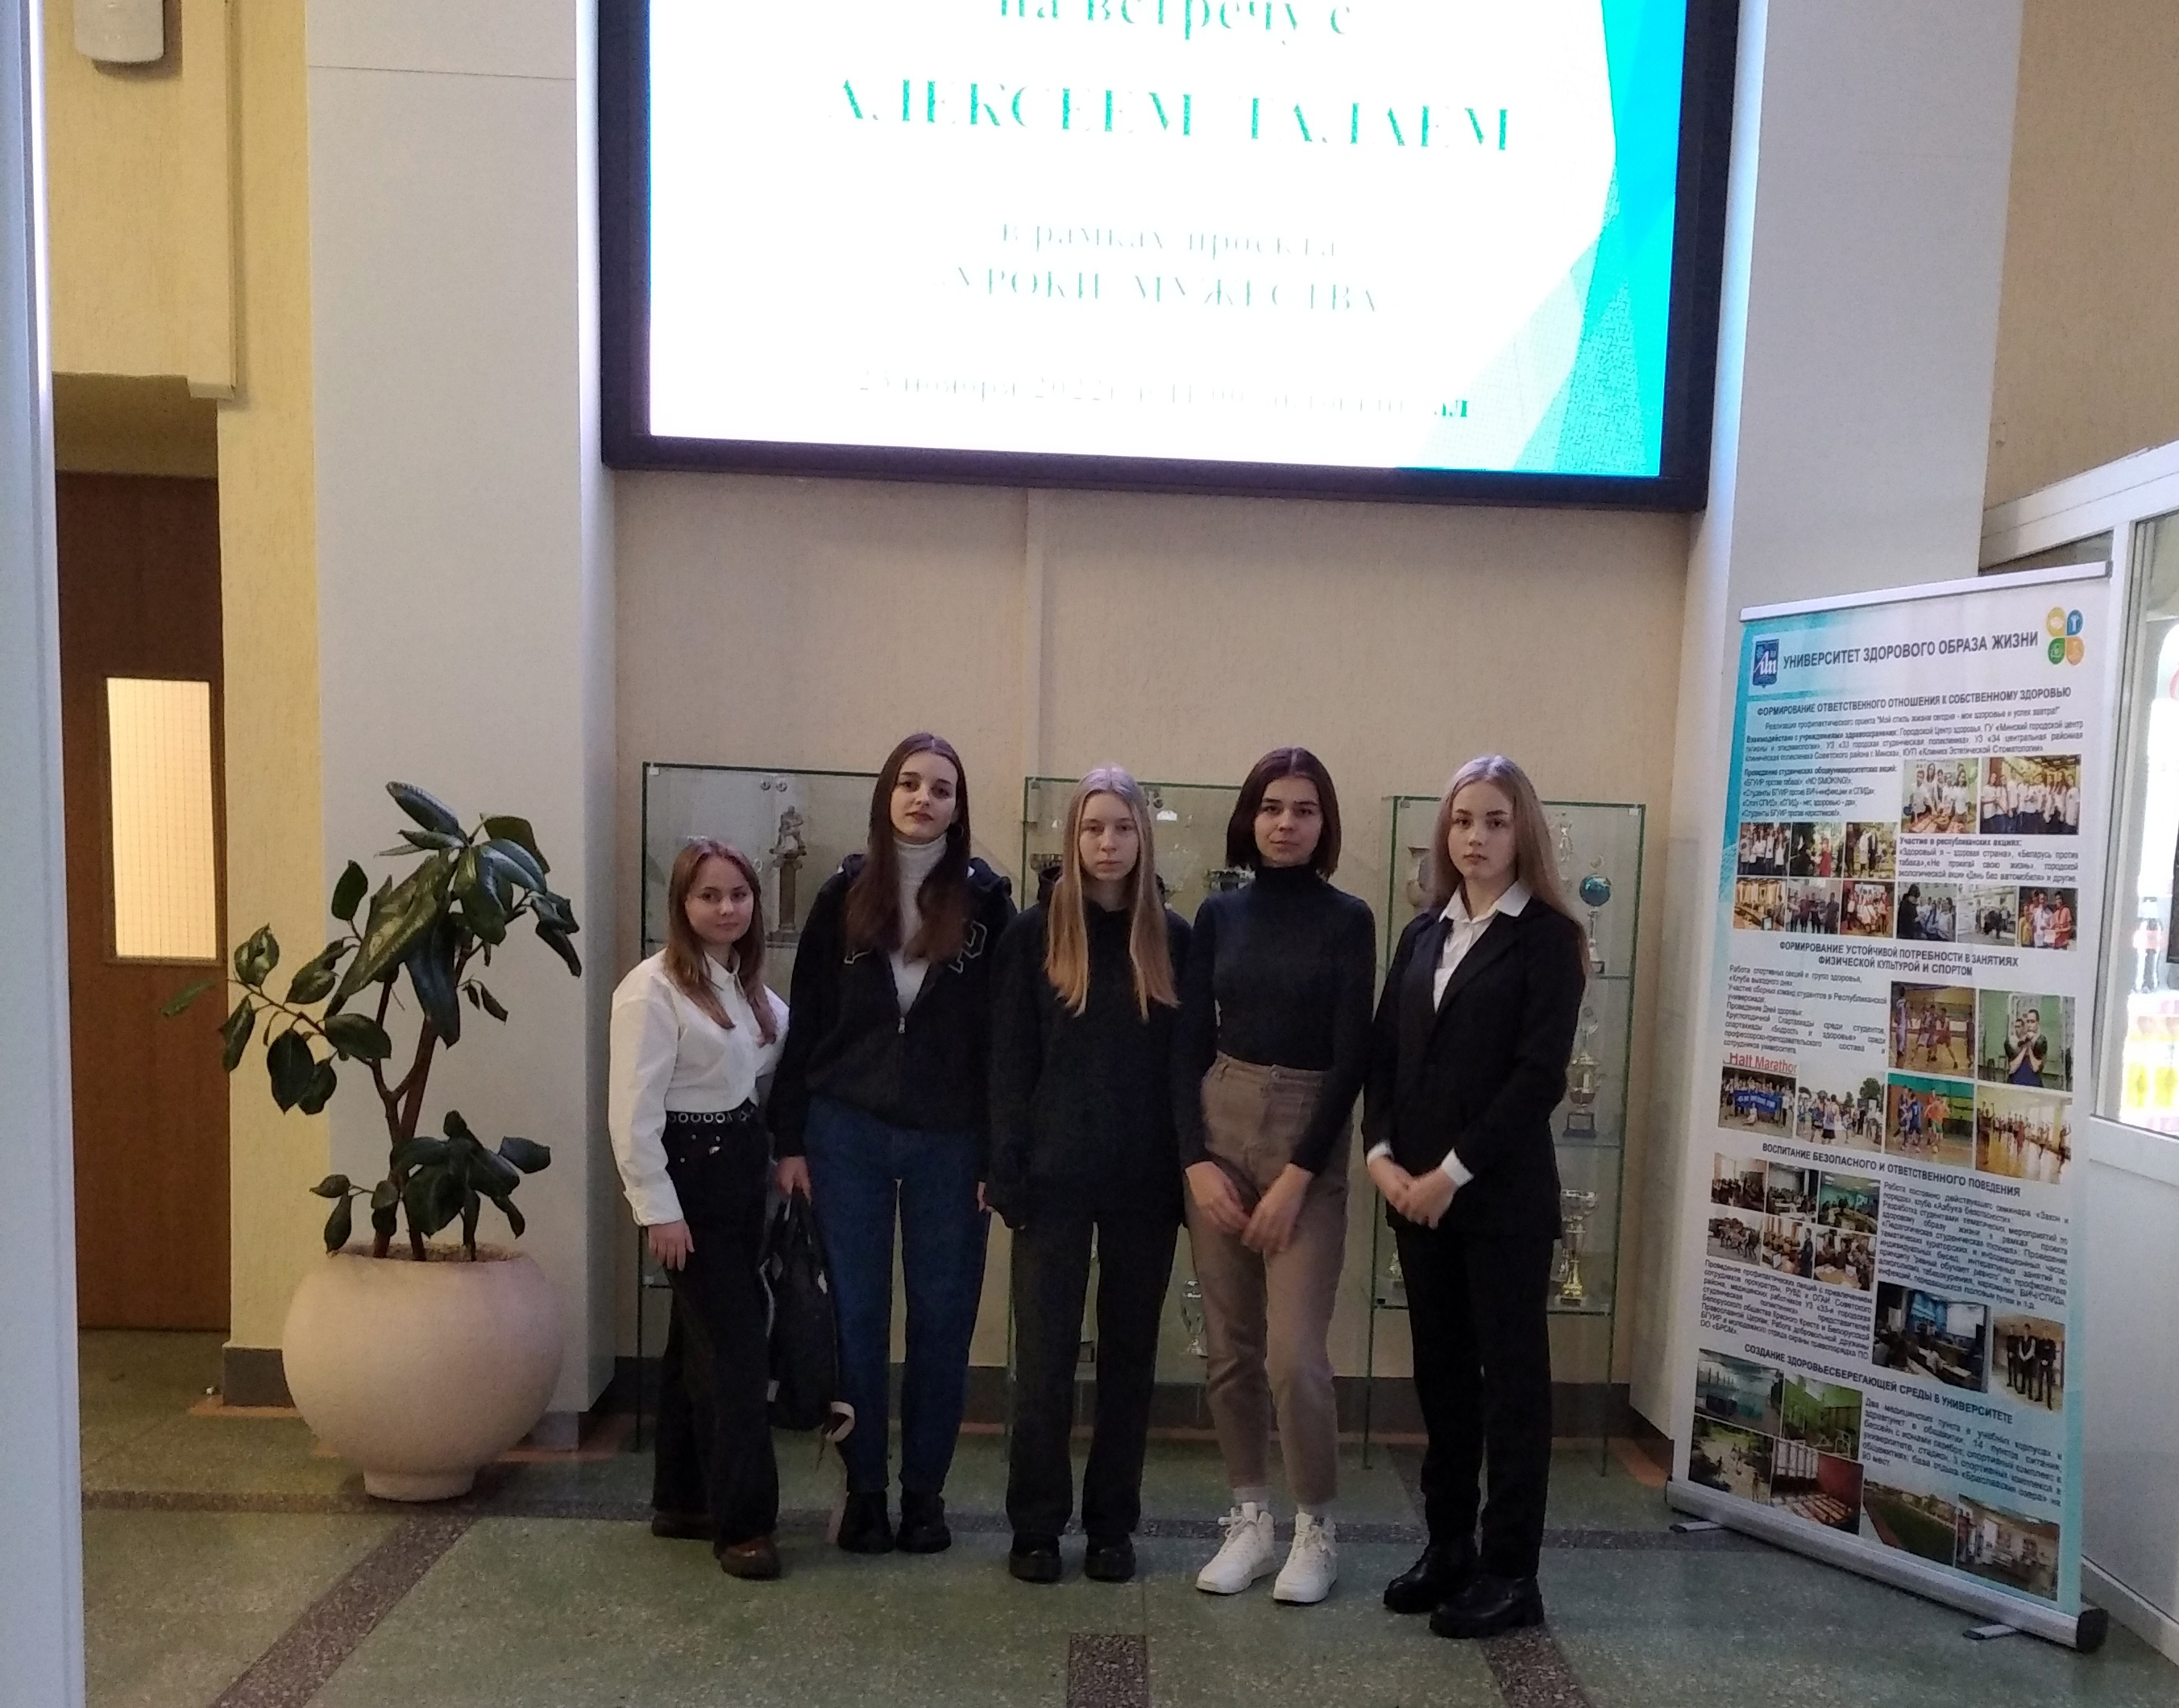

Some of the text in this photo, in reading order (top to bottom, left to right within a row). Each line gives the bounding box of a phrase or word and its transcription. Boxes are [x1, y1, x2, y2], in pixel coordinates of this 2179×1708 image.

[1783, 632, 2038, 669] УНИВЕРСИТЕТ ЗДОРОВОГО ОБРАЗА ЖИЗНИ
[1757, 686, 2071, 715] ФОРМИРОВАНИЕ ОТВЕТСТВЕННОГО ОТНОШЕНИЯ К СОБСТВЕННОМУ ЗДОРОВЬЮ
[1899, 837, 1928, 845] Участие
[1780, 941, 2019, 967] ФОРМИРОВАНИЕ УСТОЙЧИВОЙ ПОТРЕБНОСТИ В ЗАНЯТИЯХ
[1818, 956, 1973, 976] ФИЗИЧЕСКОЙ КУЛЬТУРОЙ И СПОРТОМ
[1762, 1142, 2021, 1196] ВОСПИТАНИЕ БЕЗОПАСНОГО И ОТВЕТСТВЕННОГО ПОВЕДЕНИЯ
[1745, 1344, 2013, 1424] СОЗДАНИЕ ЗДОРОВЬЕСБЕРЕГАЮЩЕЙ СРЕДЫ В УНИВЕРСИТЕТЕ
